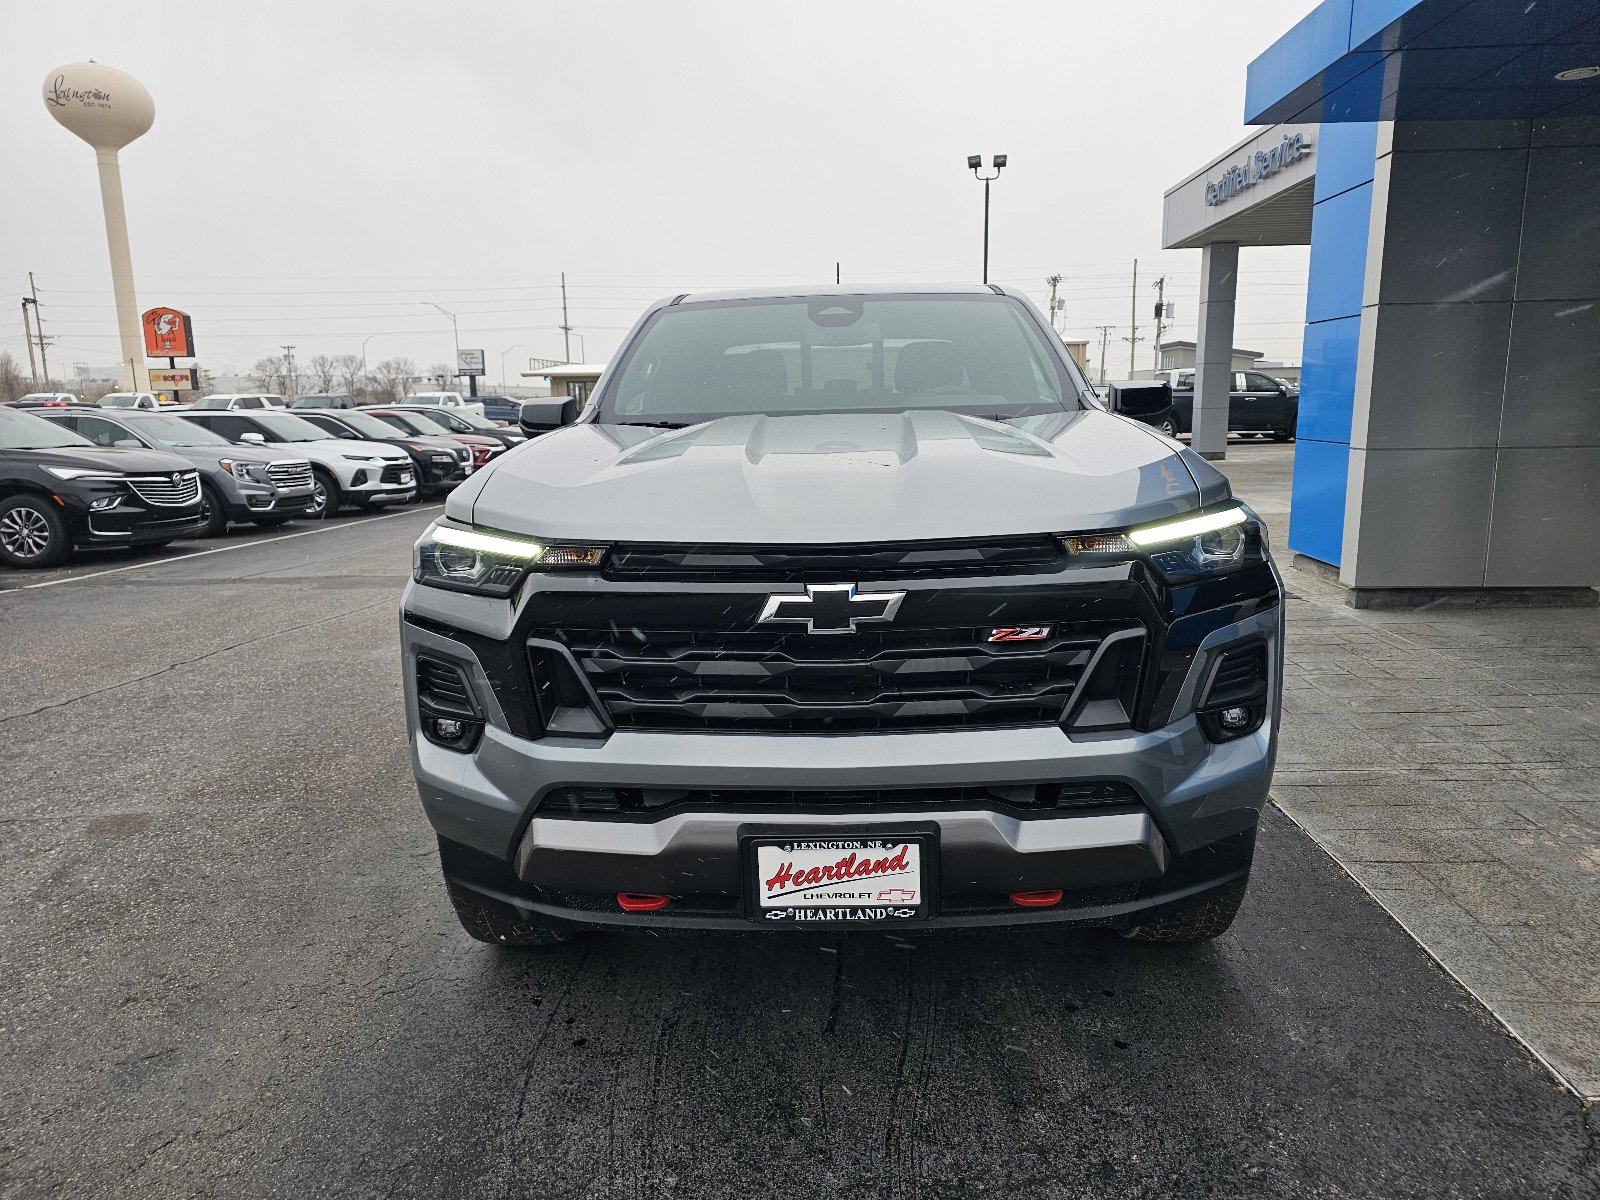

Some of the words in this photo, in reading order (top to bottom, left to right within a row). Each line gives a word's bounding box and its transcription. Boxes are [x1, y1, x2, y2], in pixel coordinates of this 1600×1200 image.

[1205, 156, 1251, 207] Certified
[1253, 132, 1304, 180] Service
[987, 627, 1051, 642] Z71
[867, 840, 883, 849] NE
[766, 844, 910, 891] Heartland
[803, 892, 873, 900] CHEVROLET
[794, 907, 887, 921] HEARTLAND
